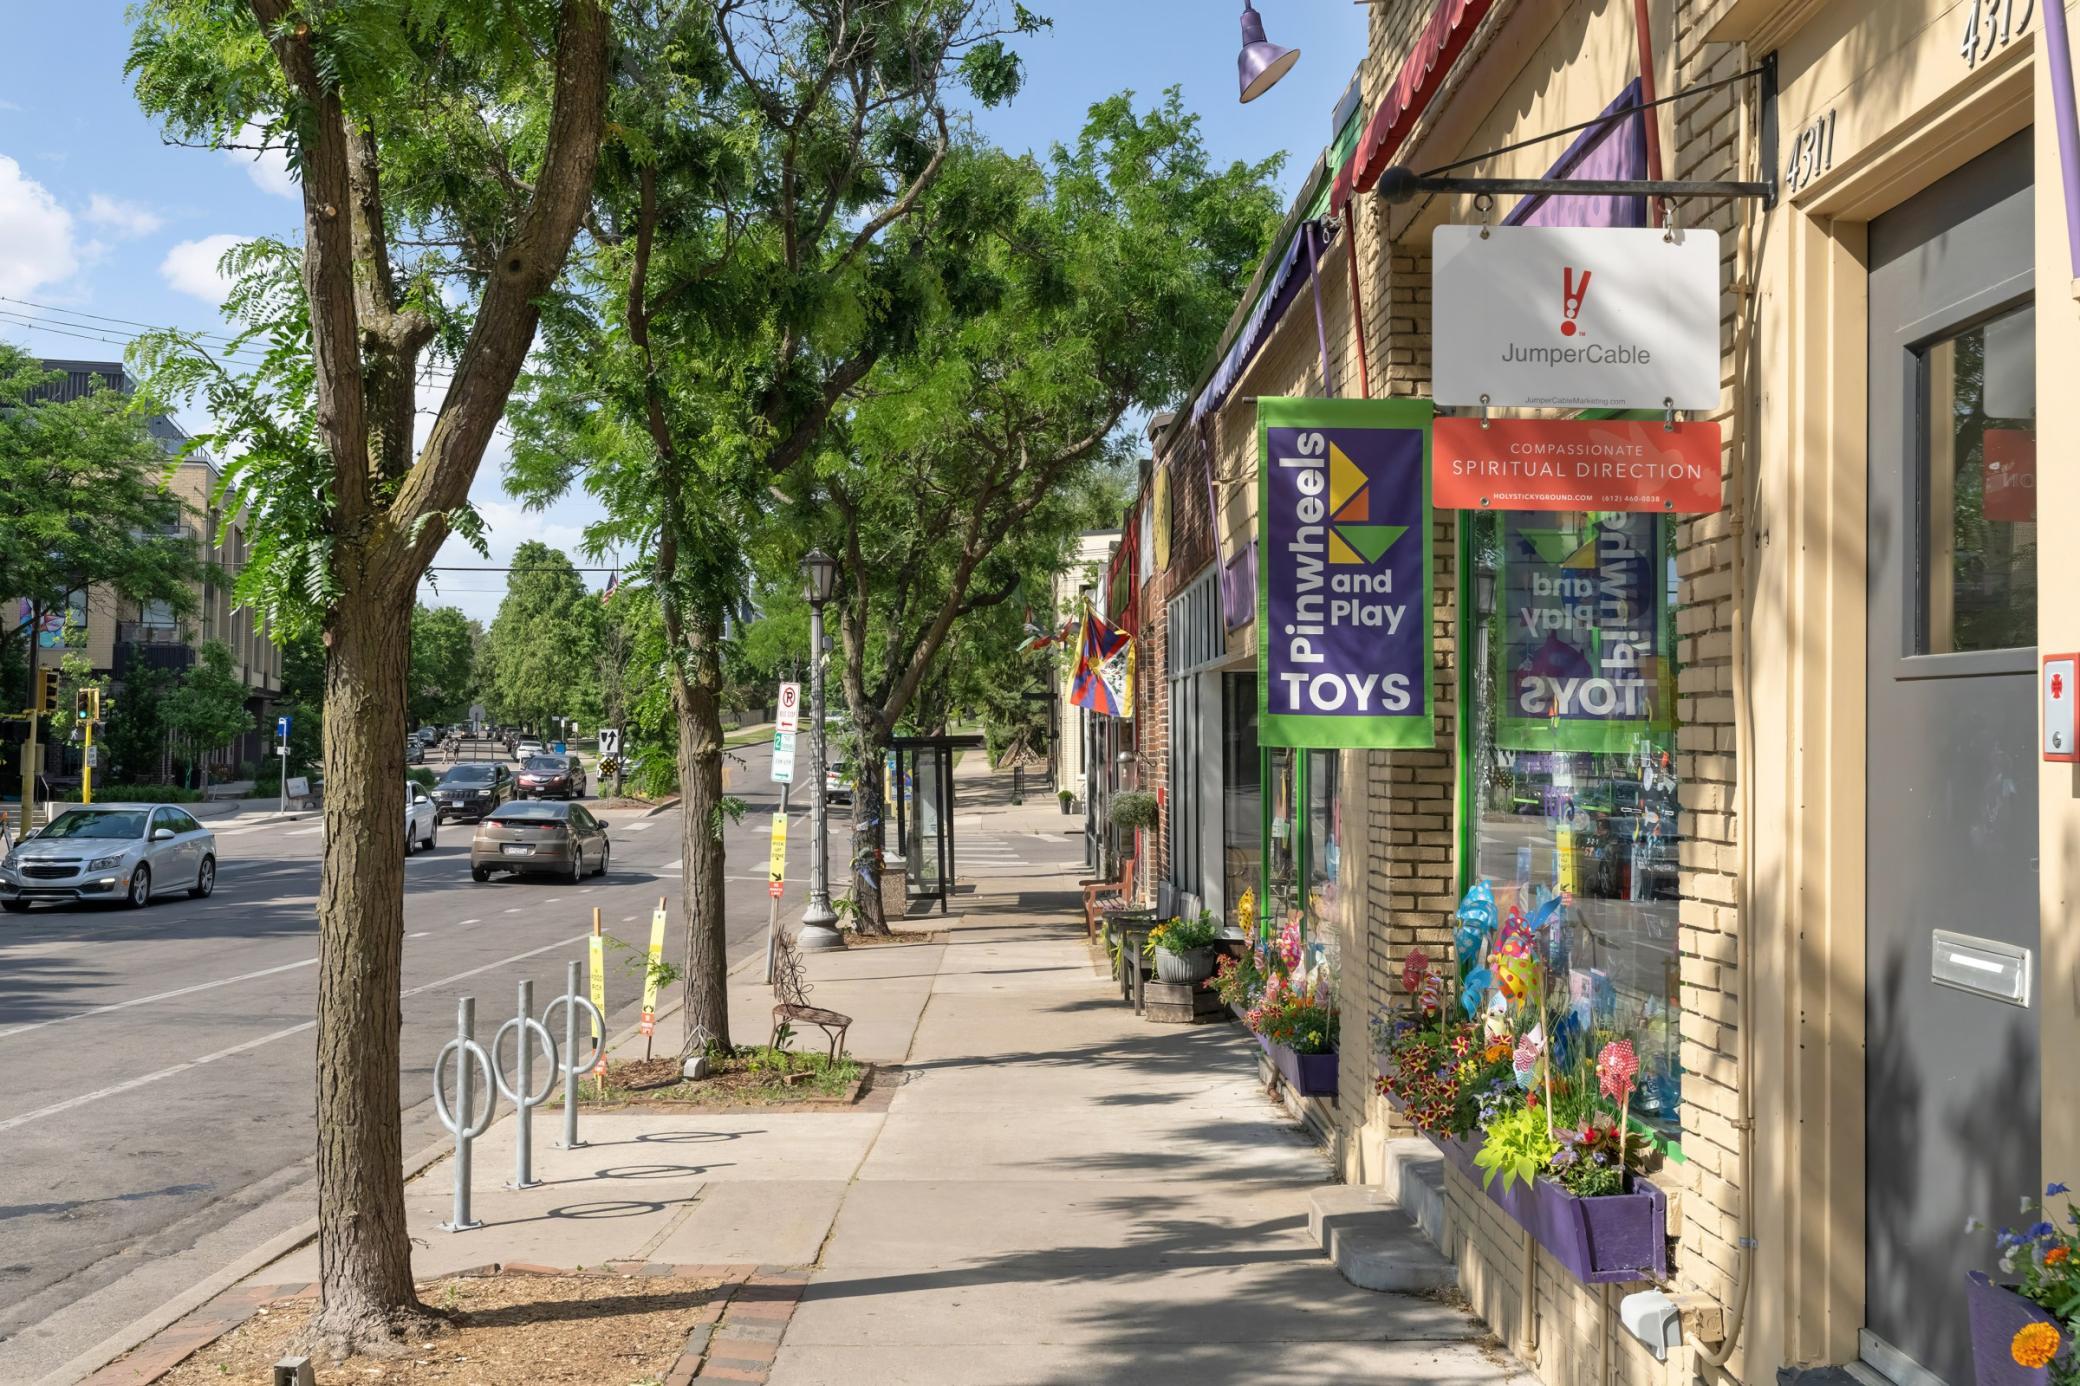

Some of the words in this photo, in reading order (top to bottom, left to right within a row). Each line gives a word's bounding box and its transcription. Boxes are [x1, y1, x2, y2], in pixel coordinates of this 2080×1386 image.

[1786, 108, 1836, 193] 4311
[1502, 343, 1651, 367] JumperCable
[1525, 396, 1626, 406] JumperCableMarketing.com
[1511, 443, 1643, 456] COMPASSIONATE
[1453, 460, 1566, 477] SPIRITUAL
[1577, 463, 1701, 479] DIRECTION
[1493, 493, 1593, 501] HOLYSTICKYGROUND.COM
[1279, 432, 1325, 663] Pinwheels
[1331, 569, 1392, 594] and
[1331, 600, 1406, 635] Play
[1281, 673, 1411, 711] TOYS
